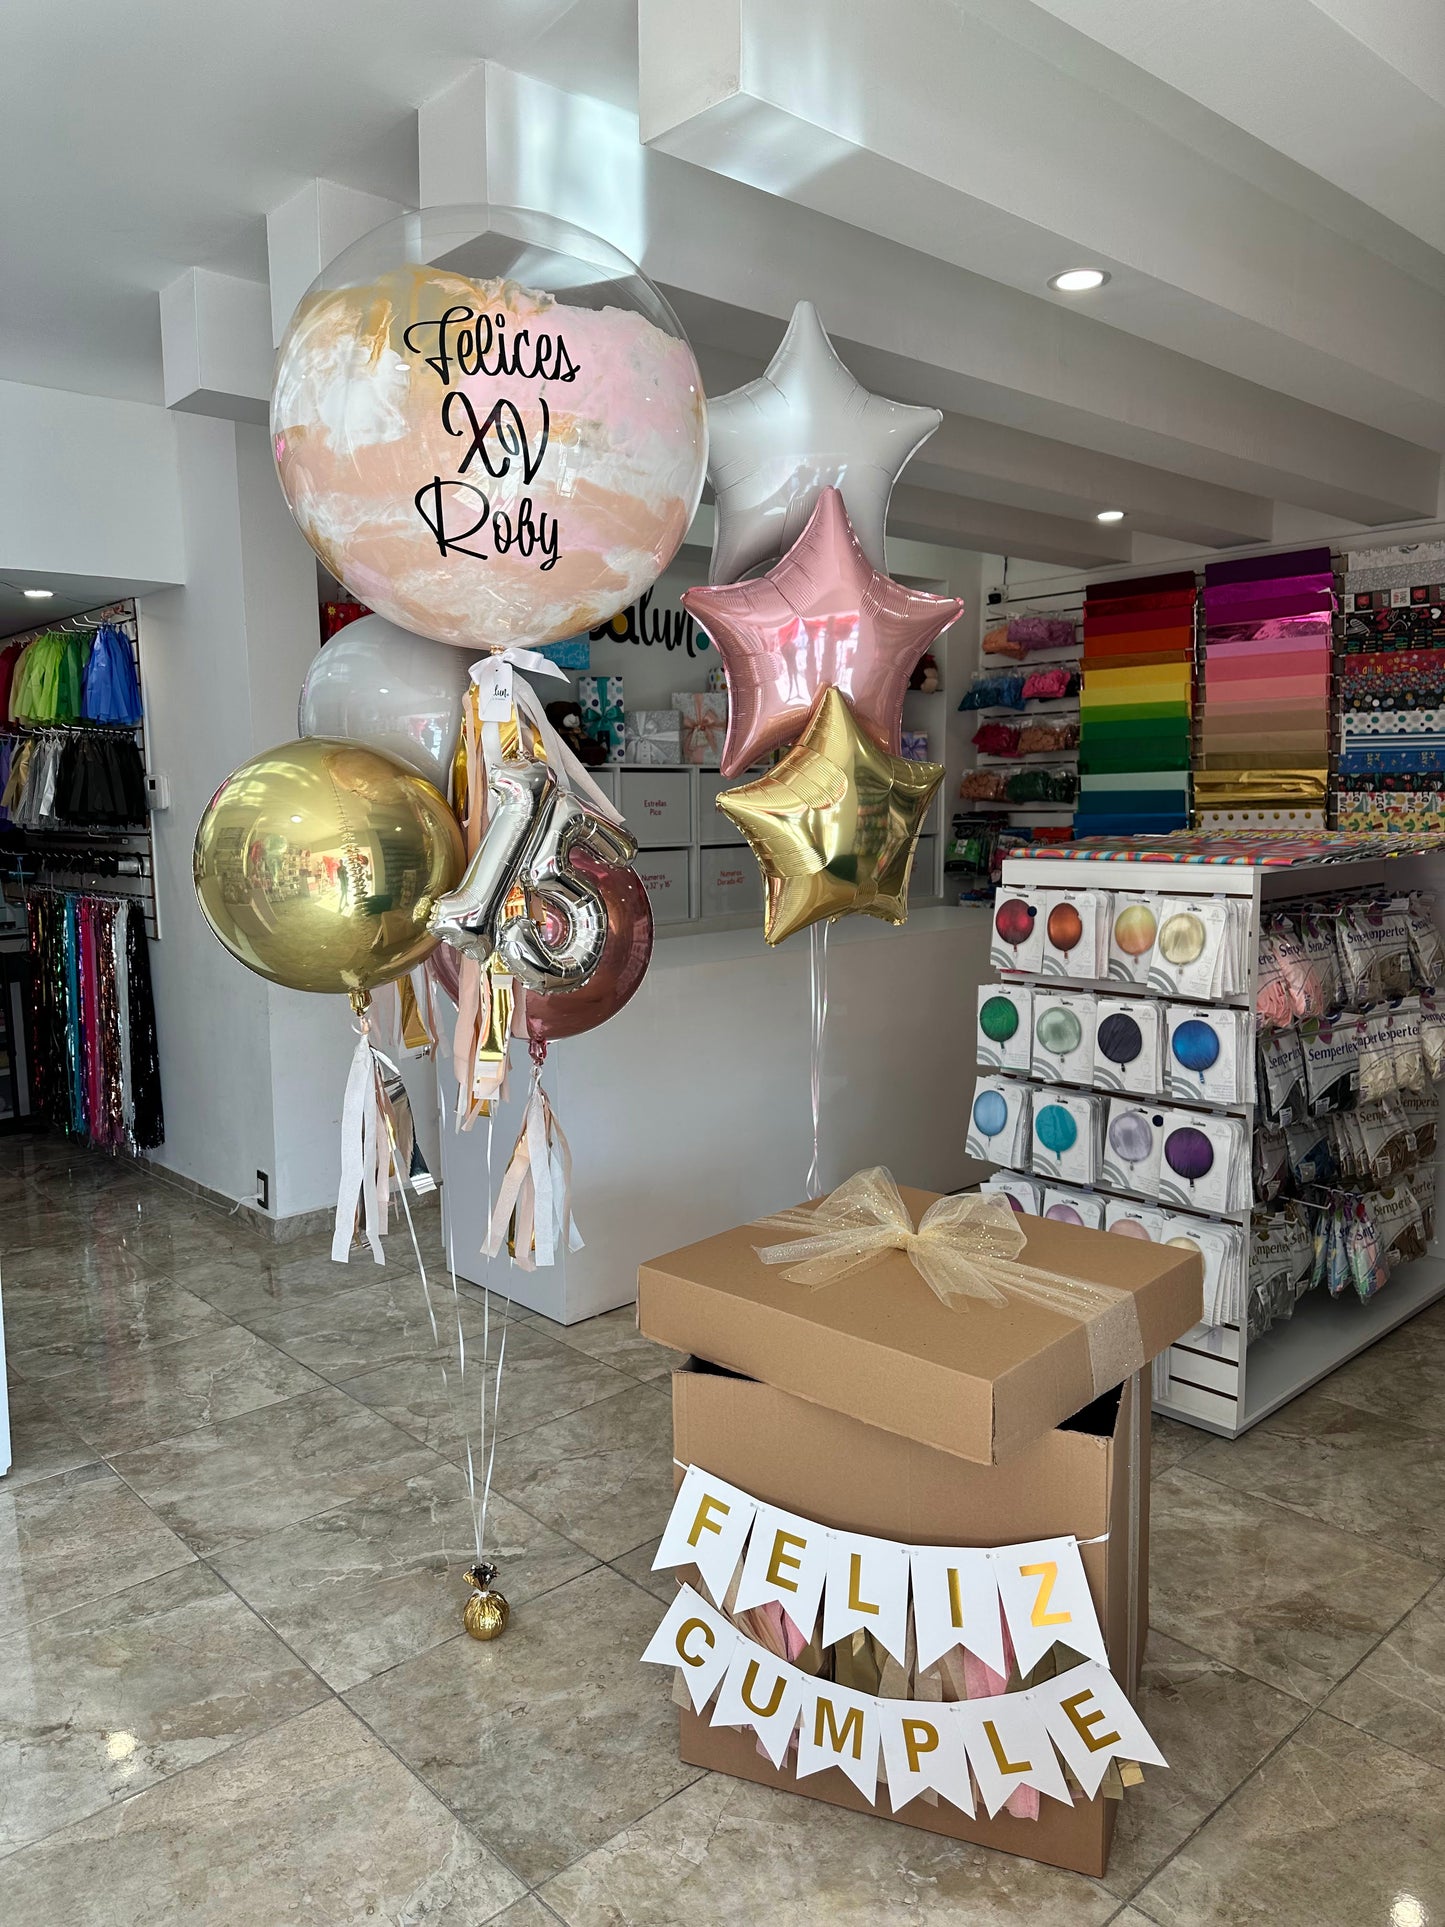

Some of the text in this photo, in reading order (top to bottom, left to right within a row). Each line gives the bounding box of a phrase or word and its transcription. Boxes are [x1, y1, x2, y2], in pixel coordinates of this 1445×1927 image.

[403, 305, 581, 386] Felices
[441, 390, 550, 486] XV
[414, 475, 563, 571] Roby
[643, 799, 668, 808] Estrellas
[649, 808, 662, 816] Pico
[1308, 1041, 1358, 1062] Sempertex
[686, 1492, 1073, 1629] FELIZ
[674, 1616, 1122, 1776] CUMPLE
